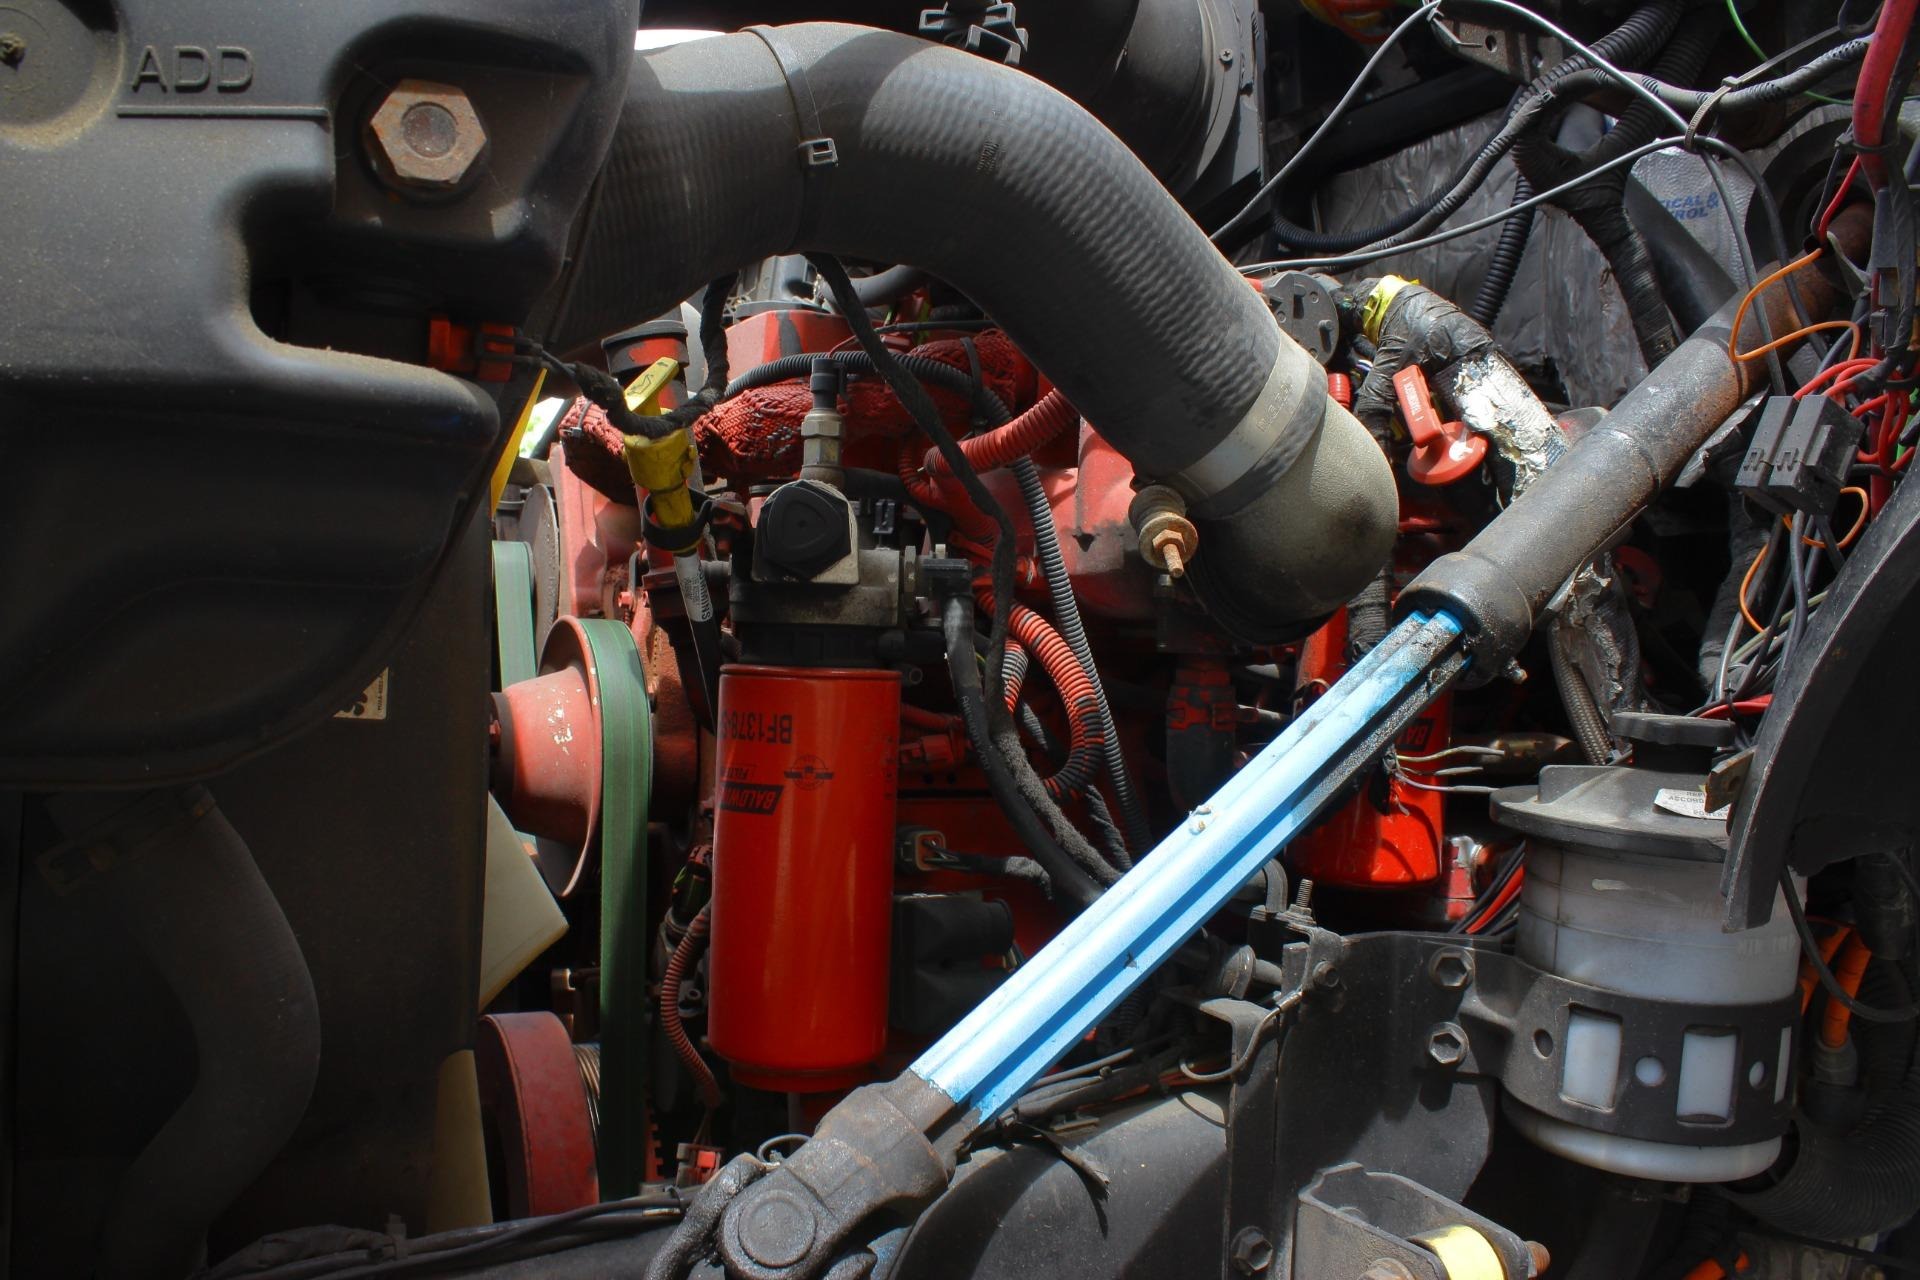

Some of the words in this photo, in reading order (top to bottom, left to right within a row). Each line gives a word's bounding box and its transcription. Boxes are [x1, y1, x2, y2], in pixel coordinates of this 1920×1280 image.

[131, 45, 255, 94] ADD
[1706, 191, 1720, 209] &
[1672, 207, 1708, 219] ROL
